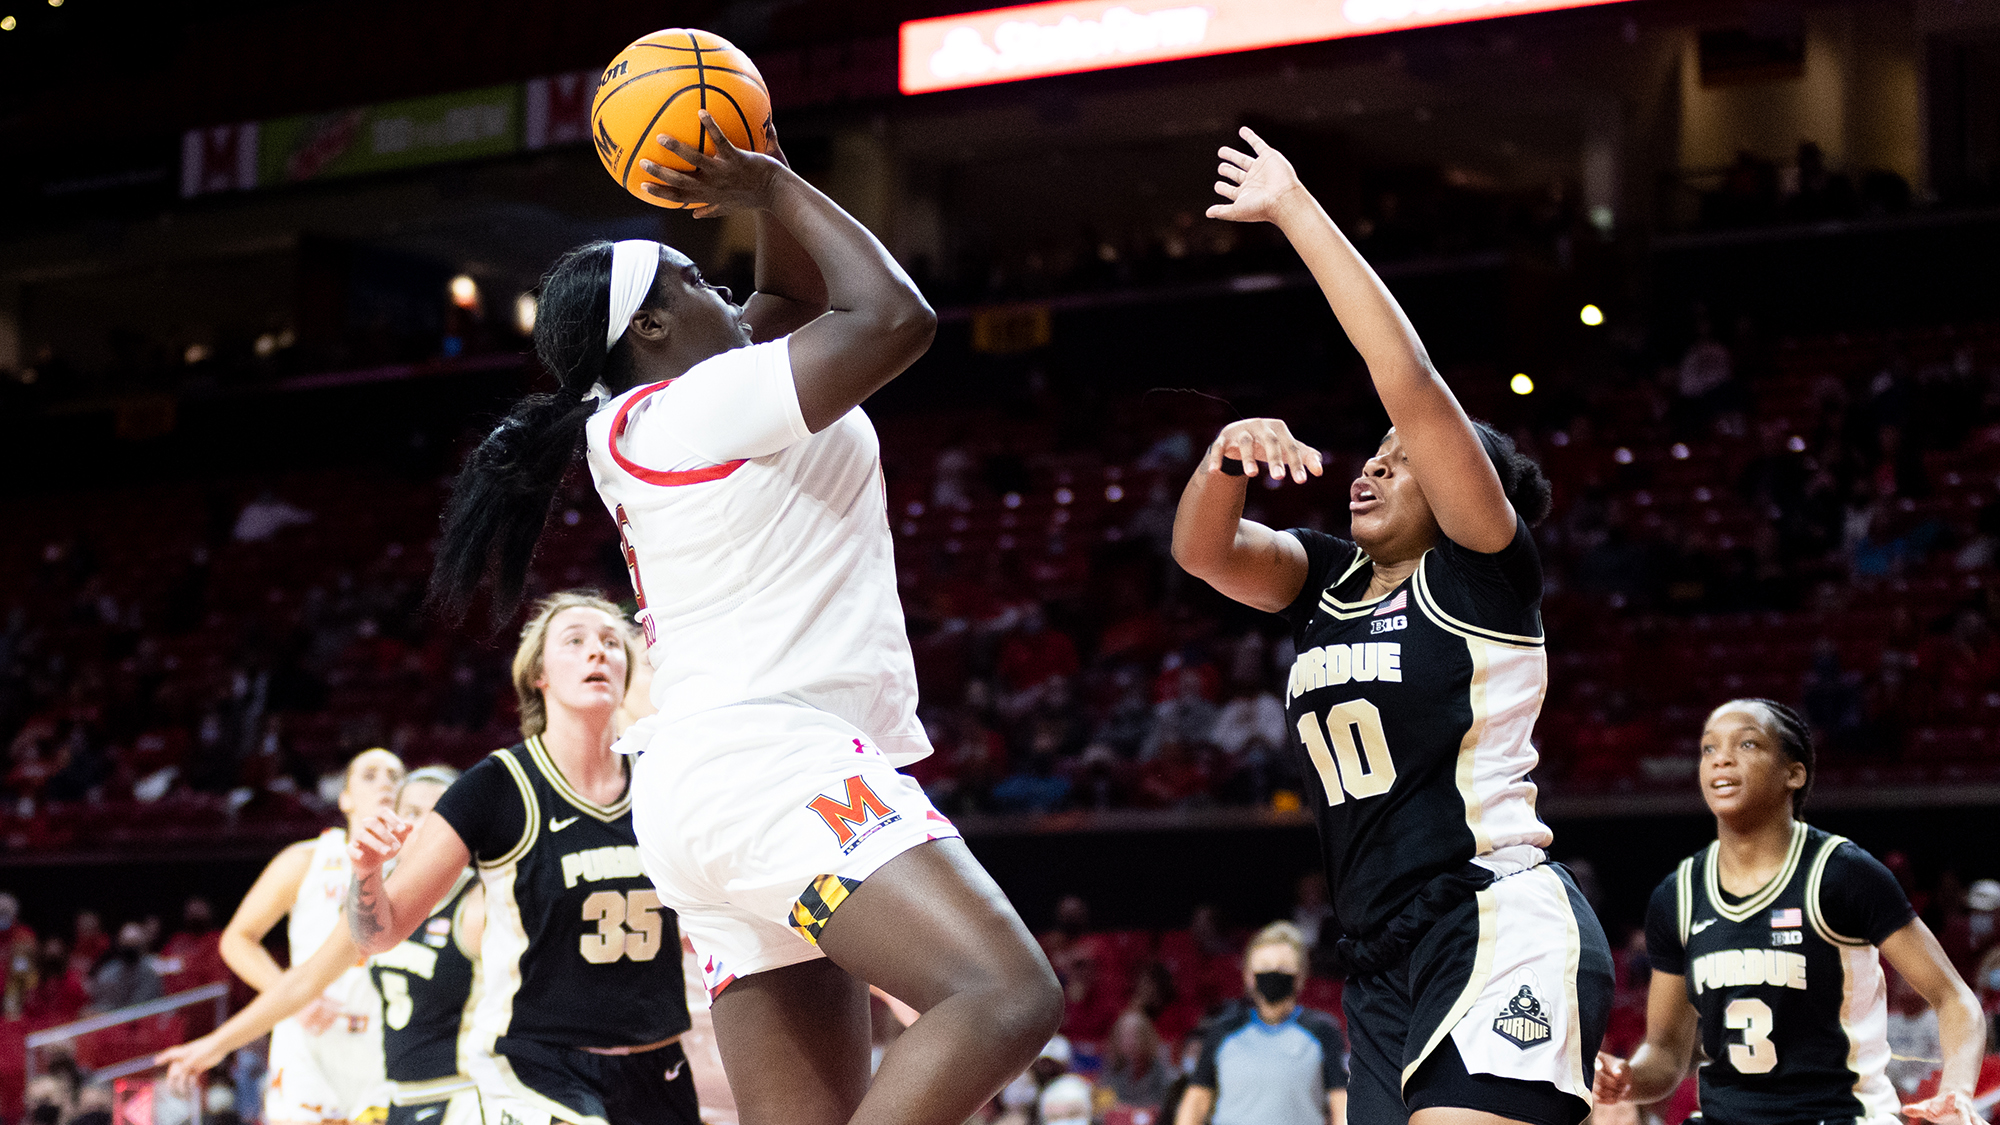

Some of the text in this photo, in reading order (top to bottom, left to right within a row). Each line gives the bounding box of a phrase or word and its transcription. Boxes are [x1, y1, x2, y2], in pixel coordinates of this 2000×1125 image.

[1297, 698, 1397, 807] 10
[806, 774, 896, 849] M
[561, 845, 650, 889] PURD
[579, 889, 663, 964] 35
[1693, 948, 1807, 995] PURDUE
[1496, 1017, 1549, 1042] PURDUE
[1726, 998, 1778, 1074] 3
